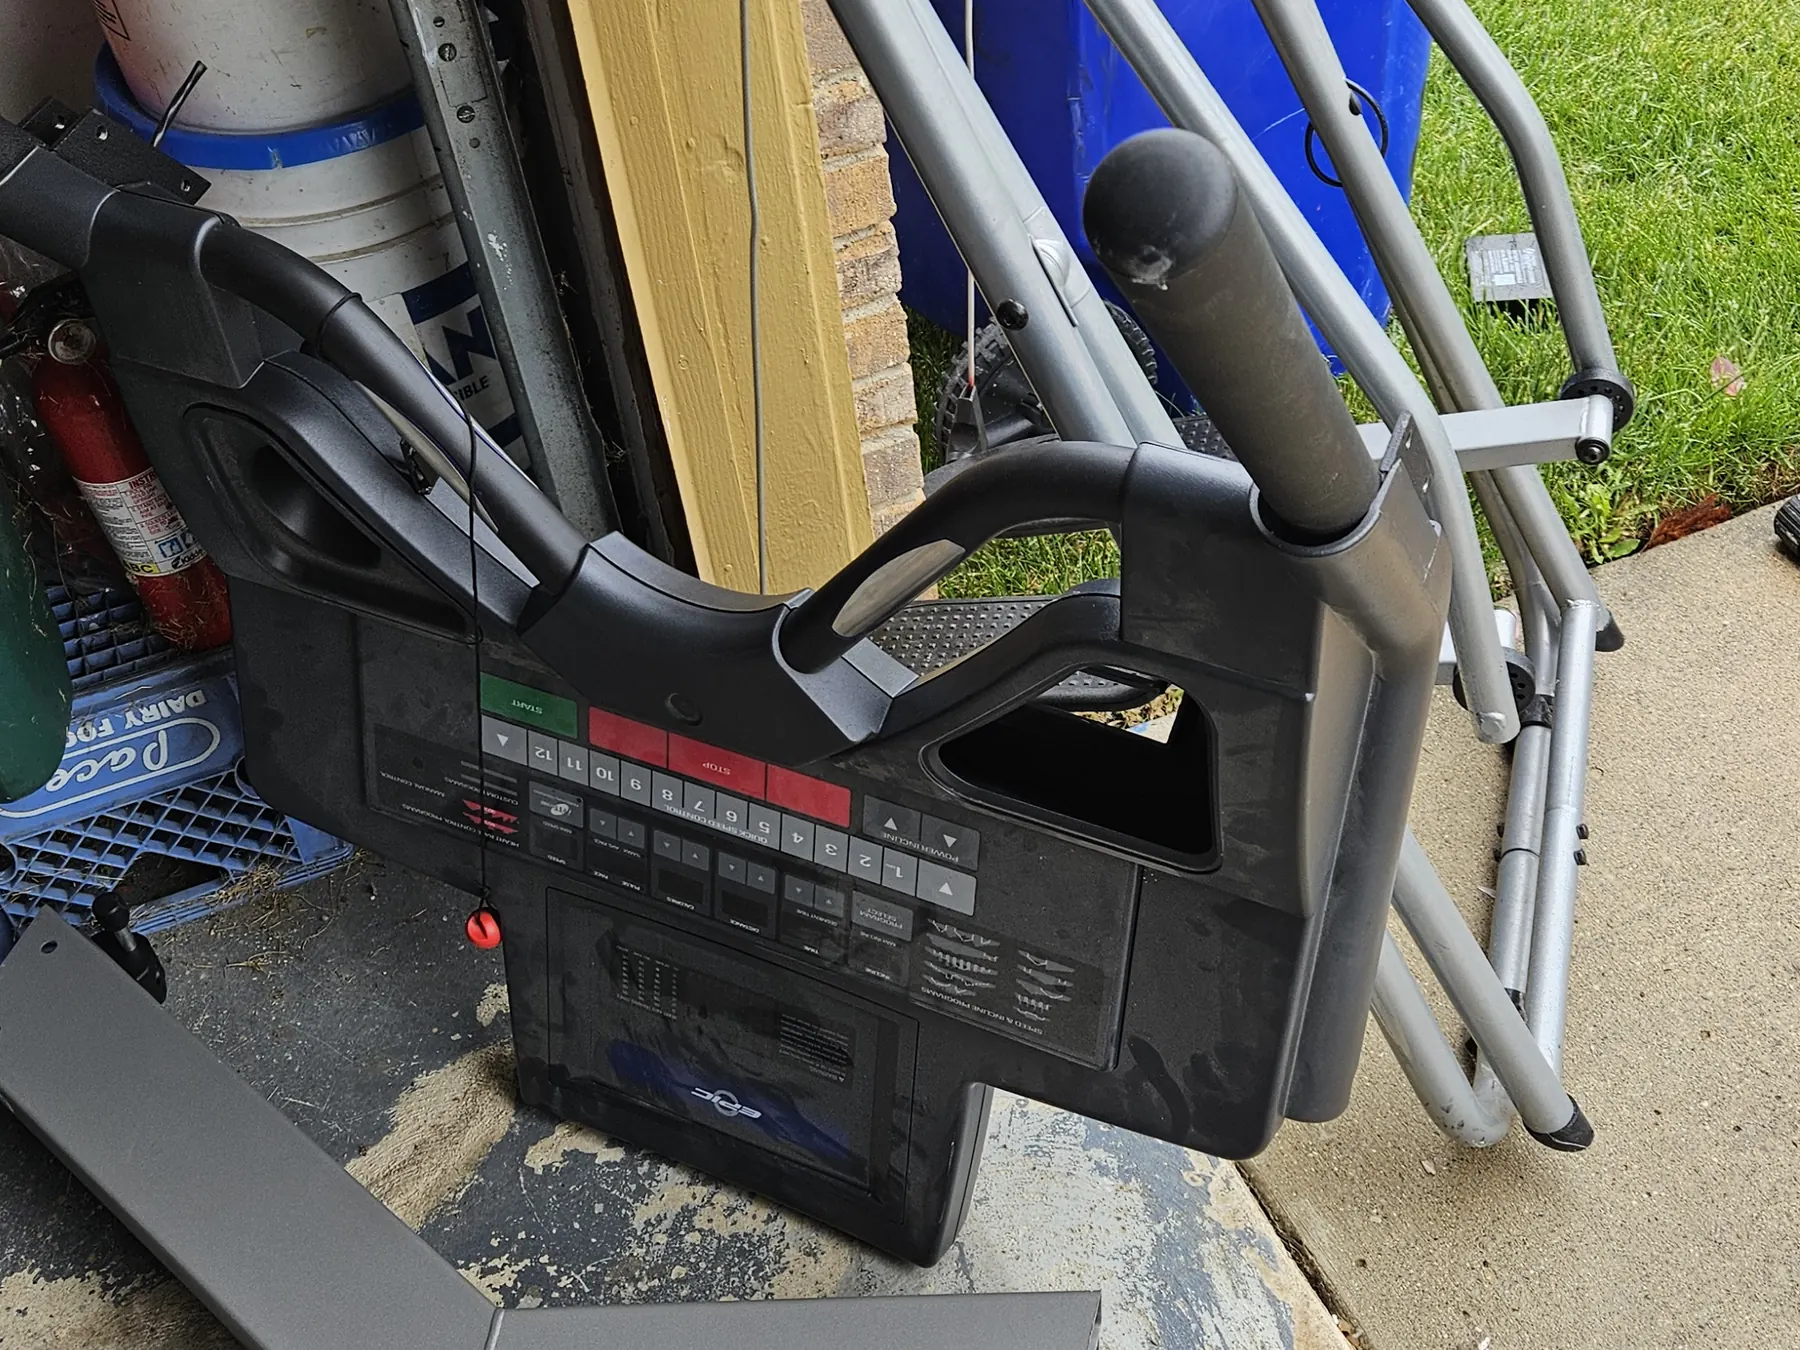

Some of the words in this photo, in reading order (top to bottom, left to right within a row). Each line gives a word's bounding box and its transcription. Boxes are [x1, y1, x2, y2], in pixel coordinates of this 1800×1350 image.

[125, 690, 207, 729] DAIRY
[512, 700, 542, 714] START
[535, 746, 552, 760] 12
[46, 730, 168, 792] Pace
[568, 758, 582, 770] 11
[596, 768, 613, 781] 10
[703, 763, 730, 774] STOP
[380, 772, 412, 786] CONTROL
[631, 779, 641, 790] 9
[415, 784, 444, 797] MANUAL
[662, 790, 672, 800] 8
[487, 792, 518, 805] CUSTOM
[402, 804, 442, 820] PROGRAMS
[694, 801, 704, 812] 7
[665, 805, 706, 824] CONTROL
[726, 811, 737, 822] 6
[444, 818, 476, 832] CONTROL
[708, 820, 737, 834] SPEED
[759, 822, 769, 833] 5
[738, 830, 767, 844] QUICK
[792, 833, 803, 843] 4
[826, 844, 837, 855] 3
[922, 845, 958, 862] POWER
[548, 855, 565, 864] SPEED
[860, 855, 871, 867] 2
[594, 871, 608, 879] PACE
[896, 867, 903, 877] 1
[667, 897, 694, 909] CALORIES
[731, 920, 759, 932] DISTANCE
[860, 910, 902, 929] PROGRAM
[804, 946, 818, 954] TIME
[922, 987, 970, 1008] PROGRAMS
[972, 1006, 1004, 1020] INCLINE
[1015, 1021, 1042, 1034] SPEED
[691, 1088, 761, 1118] EPIC
